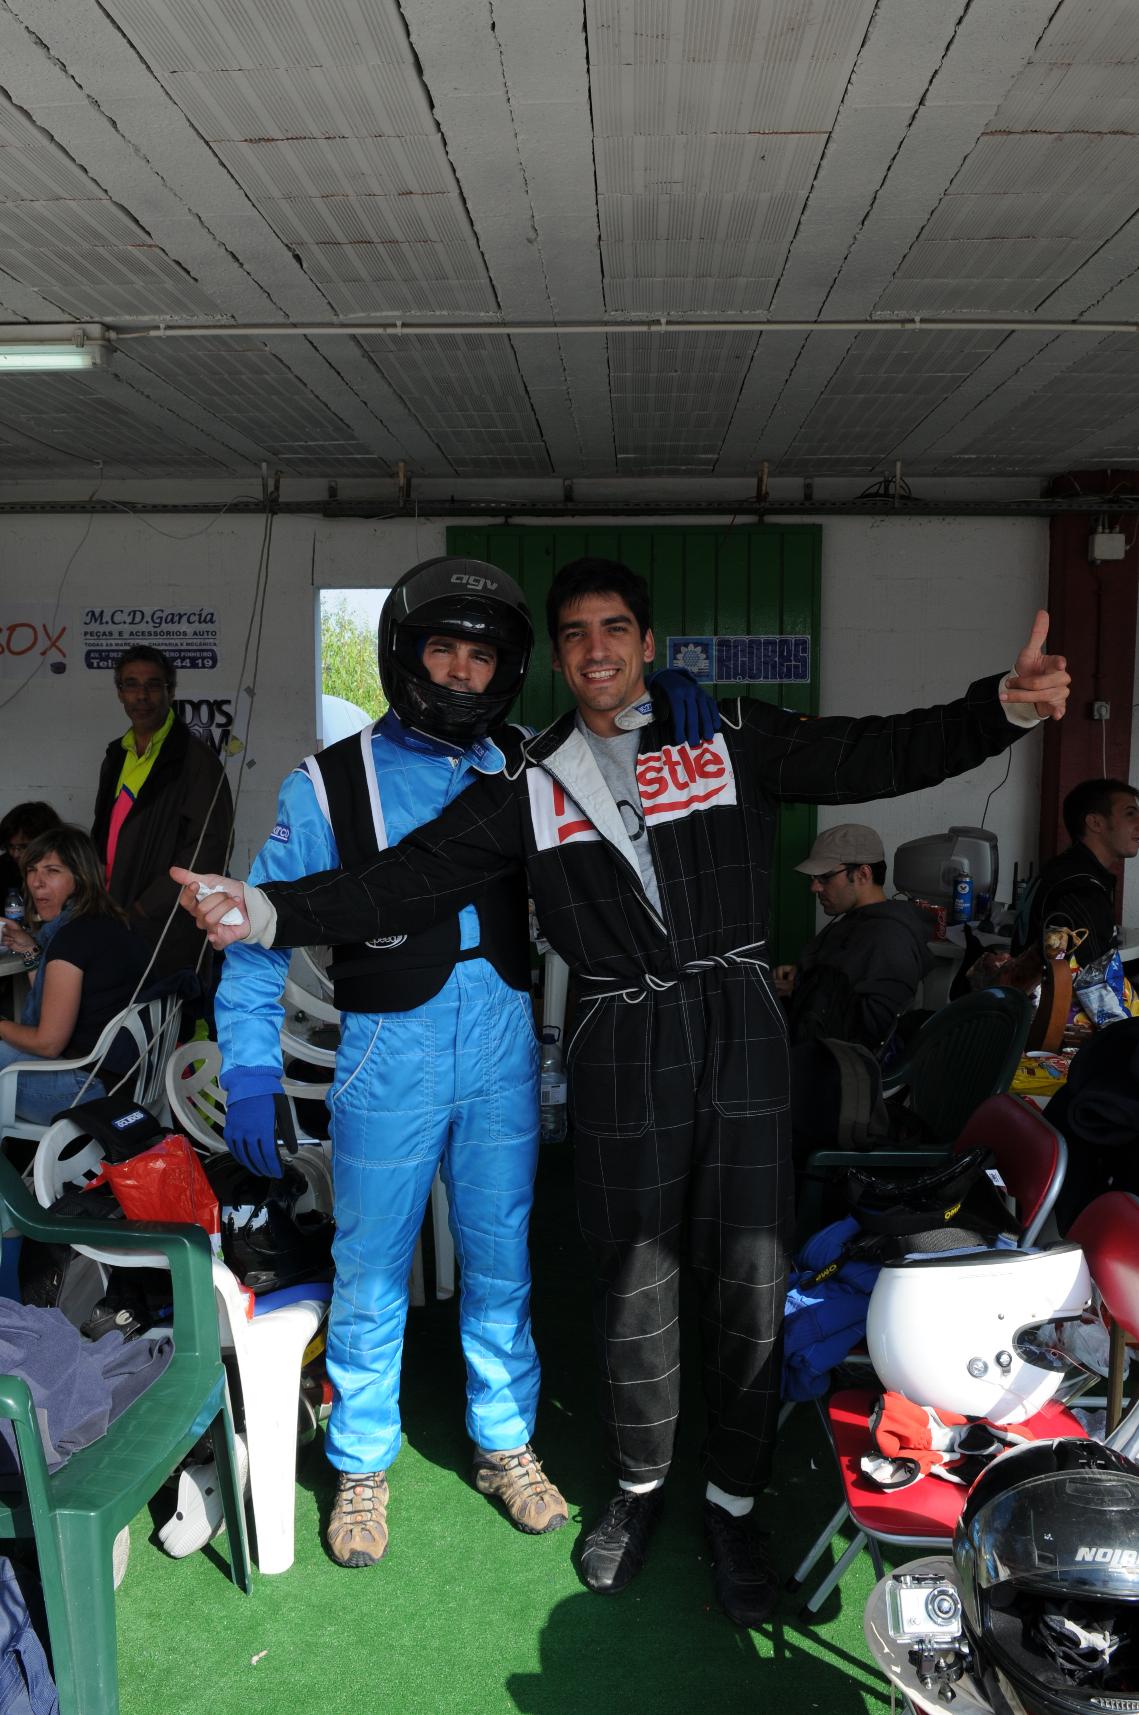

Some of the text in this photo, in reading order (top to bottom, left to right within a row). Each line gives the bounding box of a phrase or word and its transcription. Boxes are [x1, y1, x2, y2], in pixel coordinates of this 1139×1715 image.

[450, 573, 499, 591] agv
[83, 630, 113, 639] PEÇAS
[118, 630, 124, 638] E
[192, 630, 217, 638] AUTO
[193, 659, 213, 668] 19
[1074, 1547, 1139, 1568] NOLA
